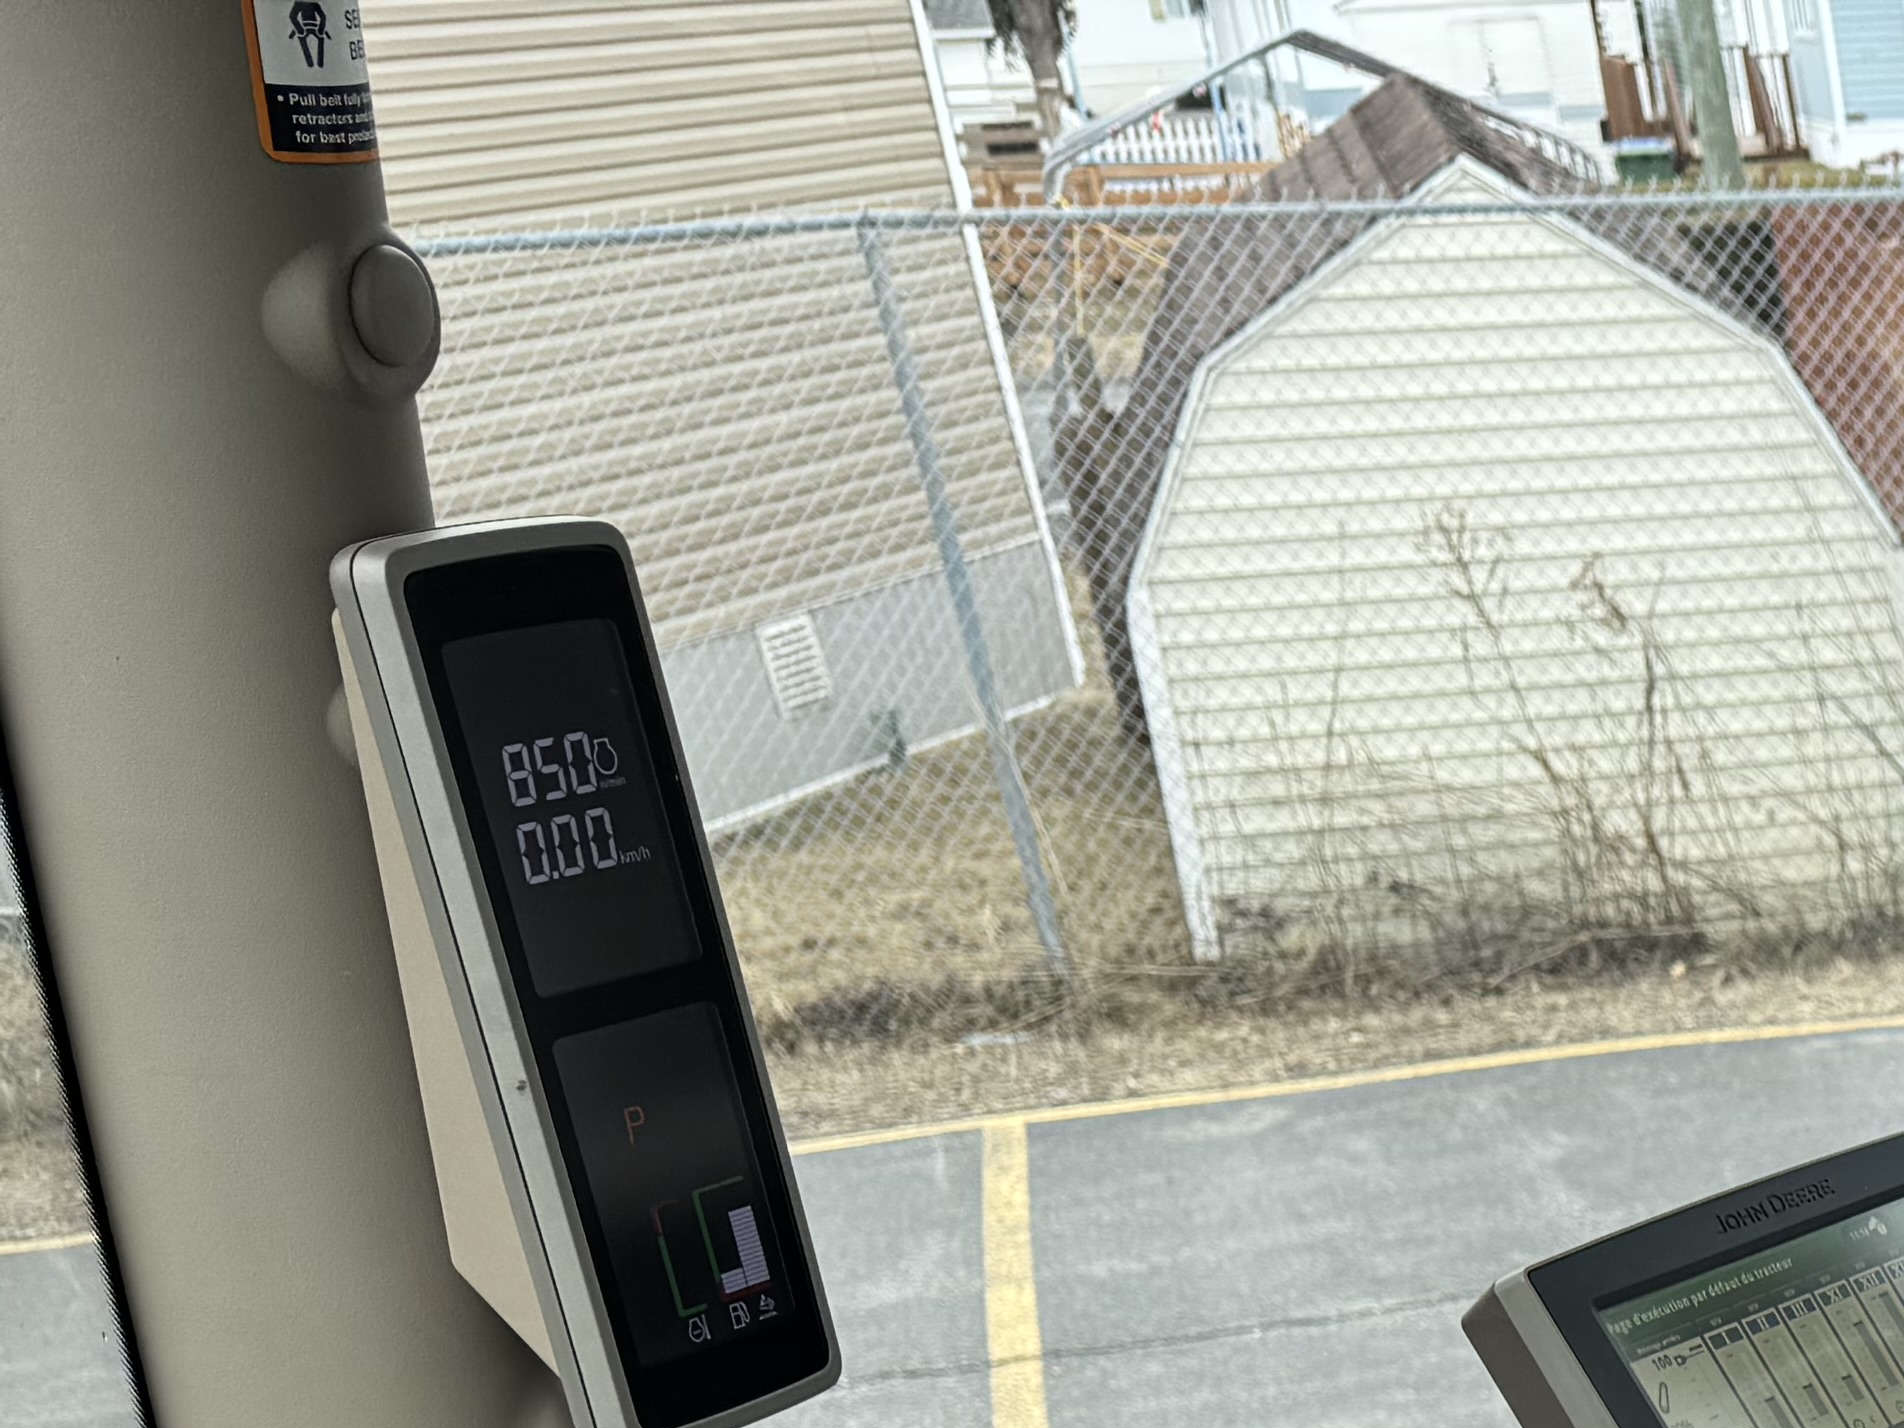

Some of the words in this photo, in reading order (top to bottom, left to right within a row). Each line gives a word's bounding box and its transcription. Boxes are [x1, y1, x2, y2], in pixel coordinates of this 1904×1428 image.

[296, 130, 315, 143] for
[502, 731, 598, 807] 850
[516, 807, 618, 885] 0.00
[624, 1105, 644, 1145] P
[1715, 1203, 1770, 1235] JOHN
[1766, 1179, 1836, 1214] DEERE
[1690, 1289, 1708, 1310] par
[1707, 1274, 1742, 1297] défaut
[1741, 1269, 1756, 1286] du
[1754, 1256, 1794, 1282] tracteur
[1826, 1287, 1844, 1303] XI
[1861, 1272, 1880, 1290] XII
[1790, 1300, 1809, 1318] III
[1651, 1353, 1673, 1372] 100
